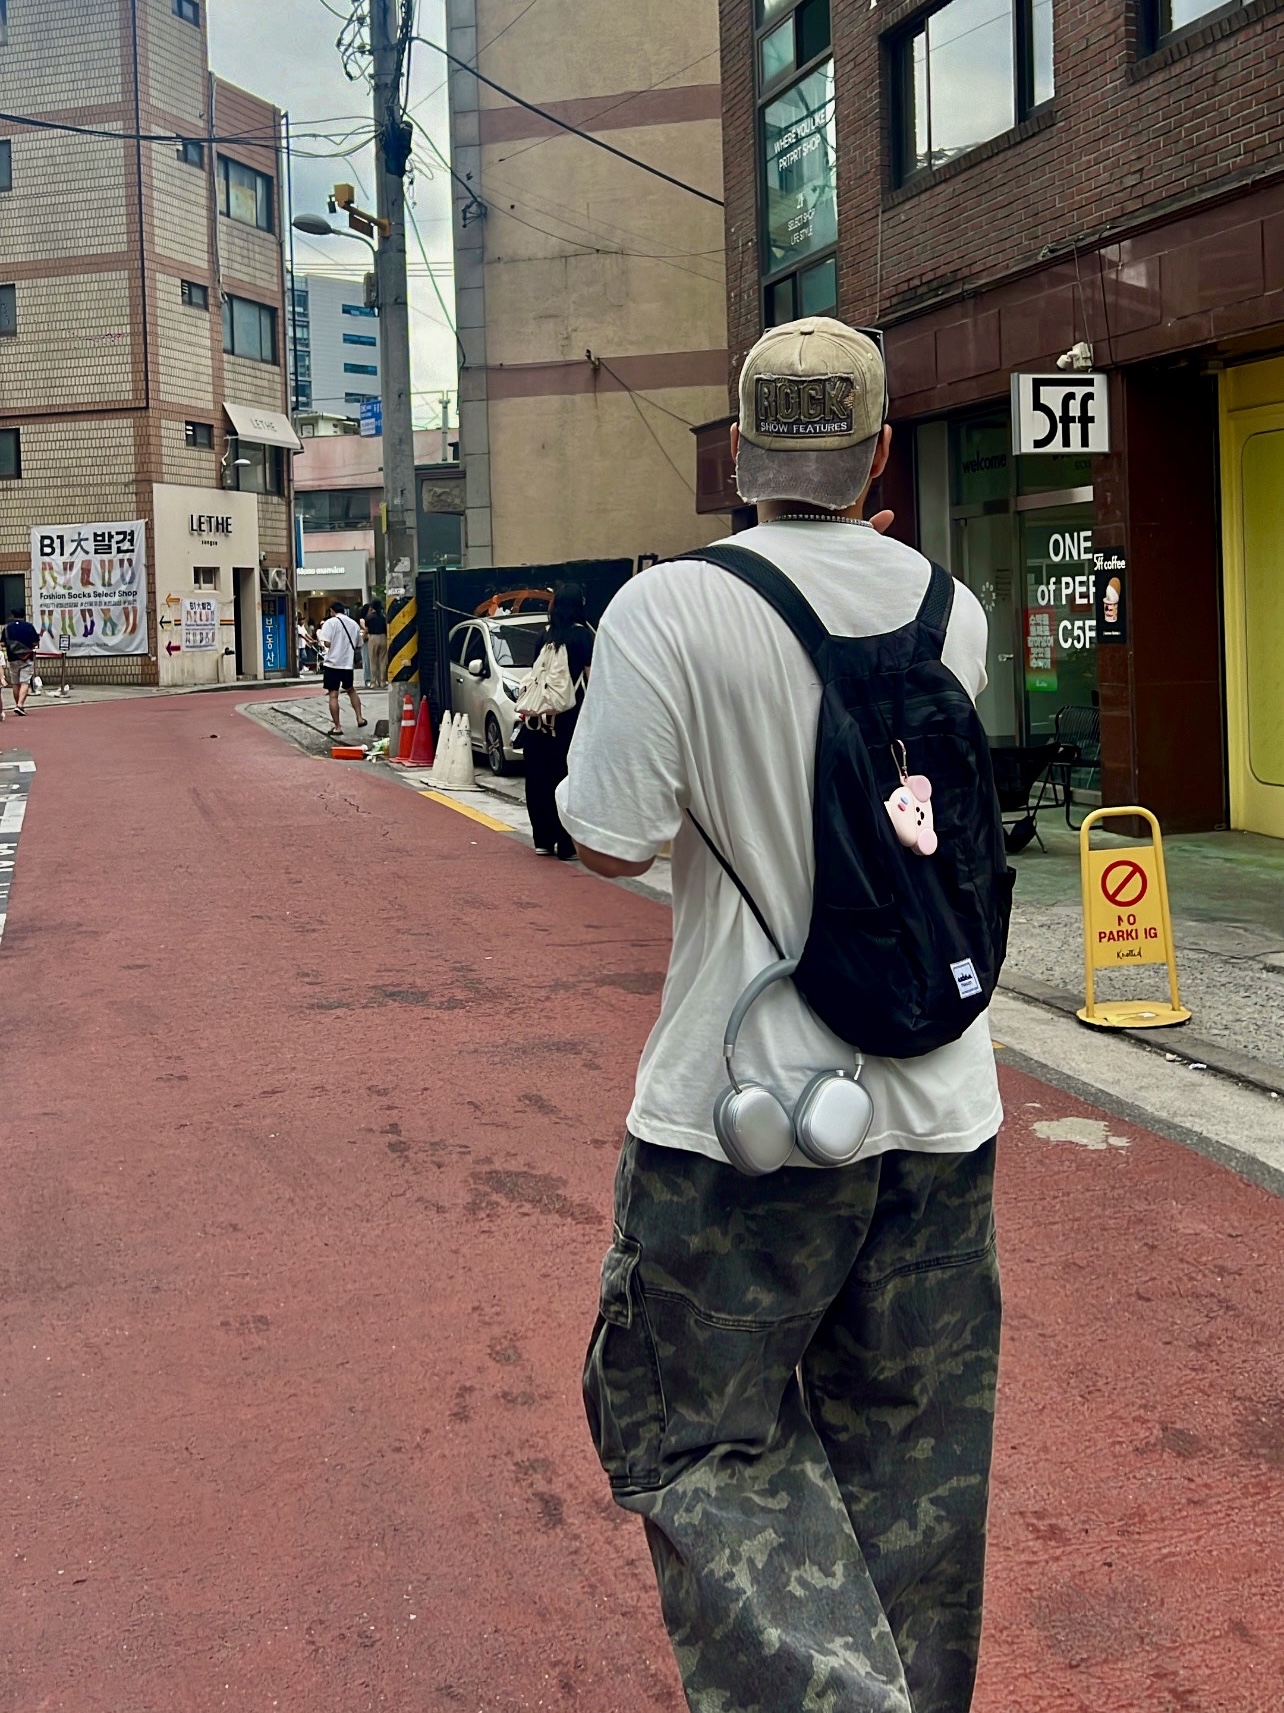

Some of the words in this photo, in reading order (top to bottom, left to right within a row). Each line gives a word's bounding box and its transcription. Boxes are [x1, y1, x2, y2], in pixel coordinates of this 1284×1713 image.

[774, 129, 798, 154] WHERE
[796, 117, 811, 139] YOU
[810, 108, 826, 130] LIKE
[778, 146, 802, 171] PRTPRT
[802, 133, 822, 156] SHOP
[788, 214, 803, 231] SELECT
[758, 379, 848, 422] ROCK
[1032, 377, 1095, 449] 5ff
[250, 418, 277, 433] LETHE
[760, 421, 788, 432] SHOW
[793, 421, 848, 433] FEATURES
[962, 451, 1007, 474] welcome
[190, 514, 232, 534] LETHE
[40, 535, 65, 557] B1
[1049, 530, 1093, 562] ONE
[1093, 553, 1104, 571] 5ff
[1104, 555, 1126, 570] coffee
[40, 592, 66, 600] Fashion
[68, 591, 91, 600] Socks
[93, 590, 117, 599] Select
[118, 590, 138, 599] Shop
[1037, 577, 1056, 606] of
[265, 617, 275, 667] 부동산
